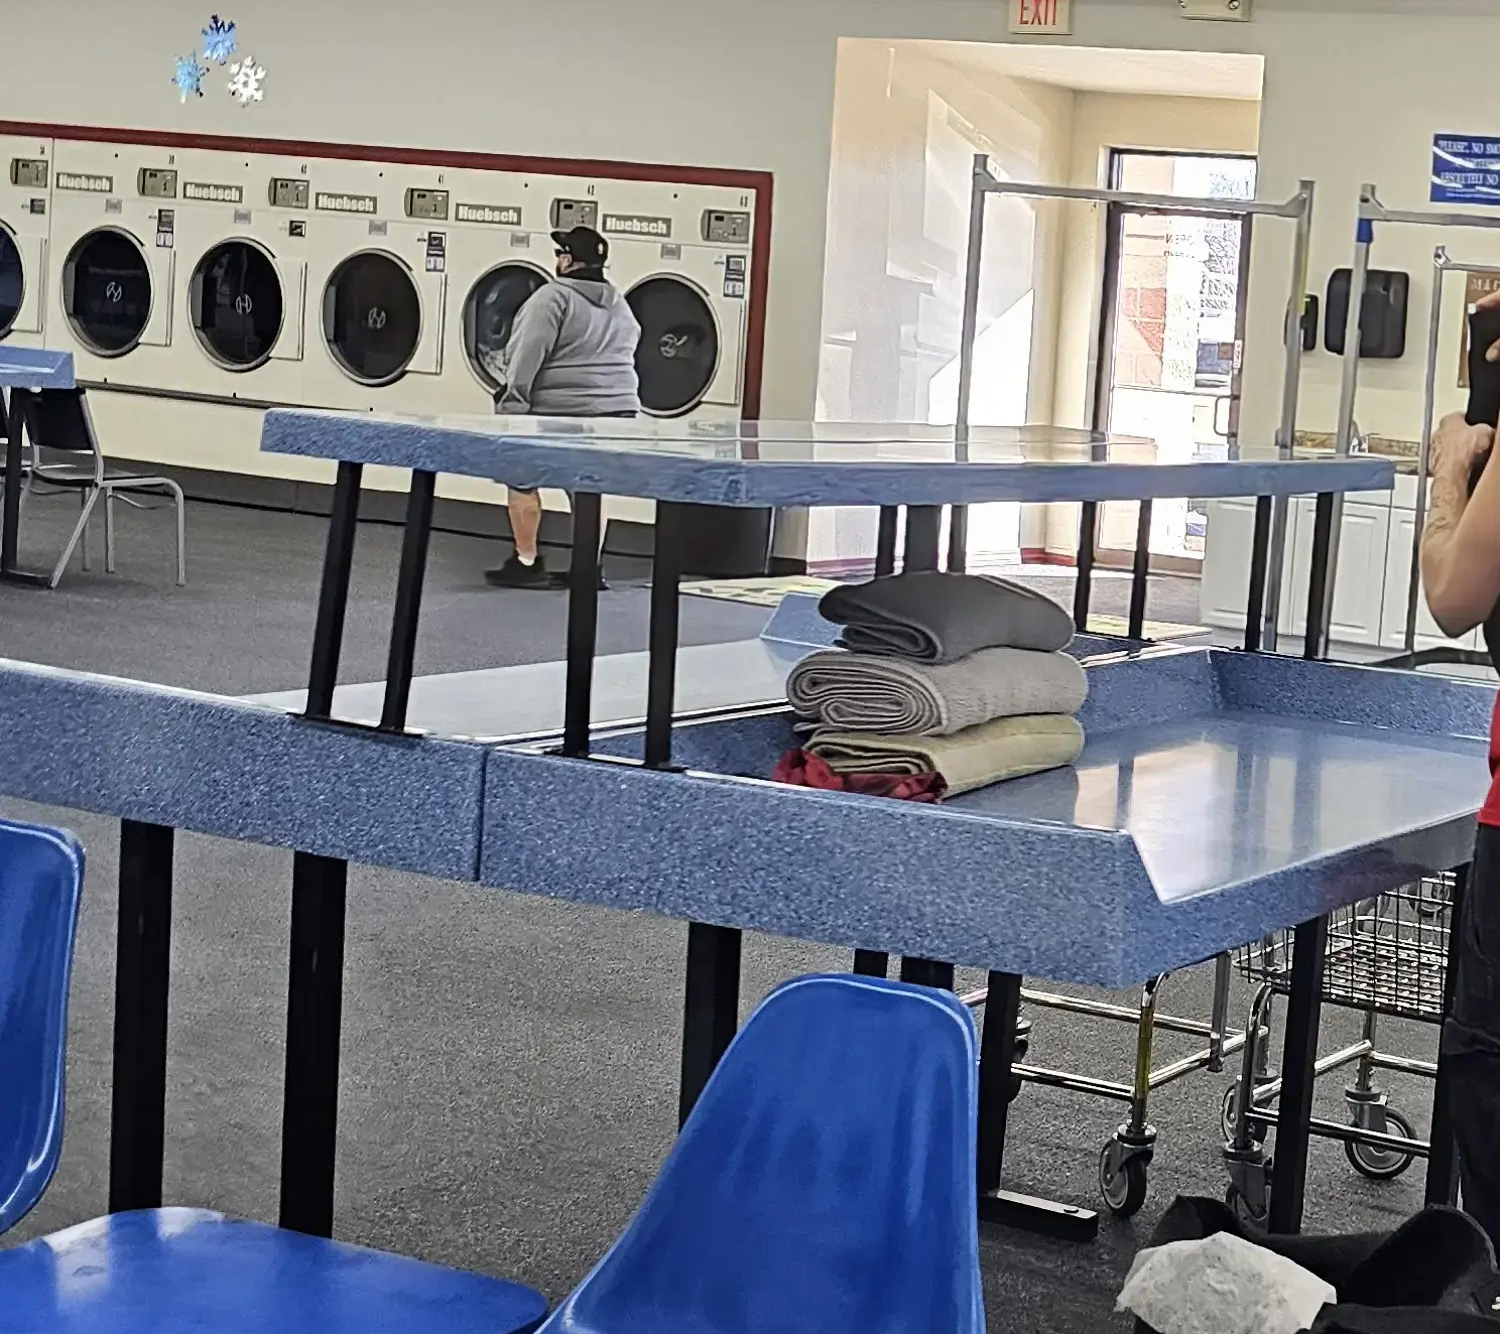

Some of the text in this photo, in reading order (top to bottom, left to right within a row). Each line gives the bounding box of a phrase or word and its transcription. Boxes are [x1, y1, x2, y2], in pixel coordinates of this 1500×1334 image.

[1486, 174, 1498, 185] NO
[186, 184, 240, 201] Huebsch
[318, 194, 374, 212] Huebsch
[458, 205, 518, 223] Huebsch
[606, 217, 667, 235] Huebsch
